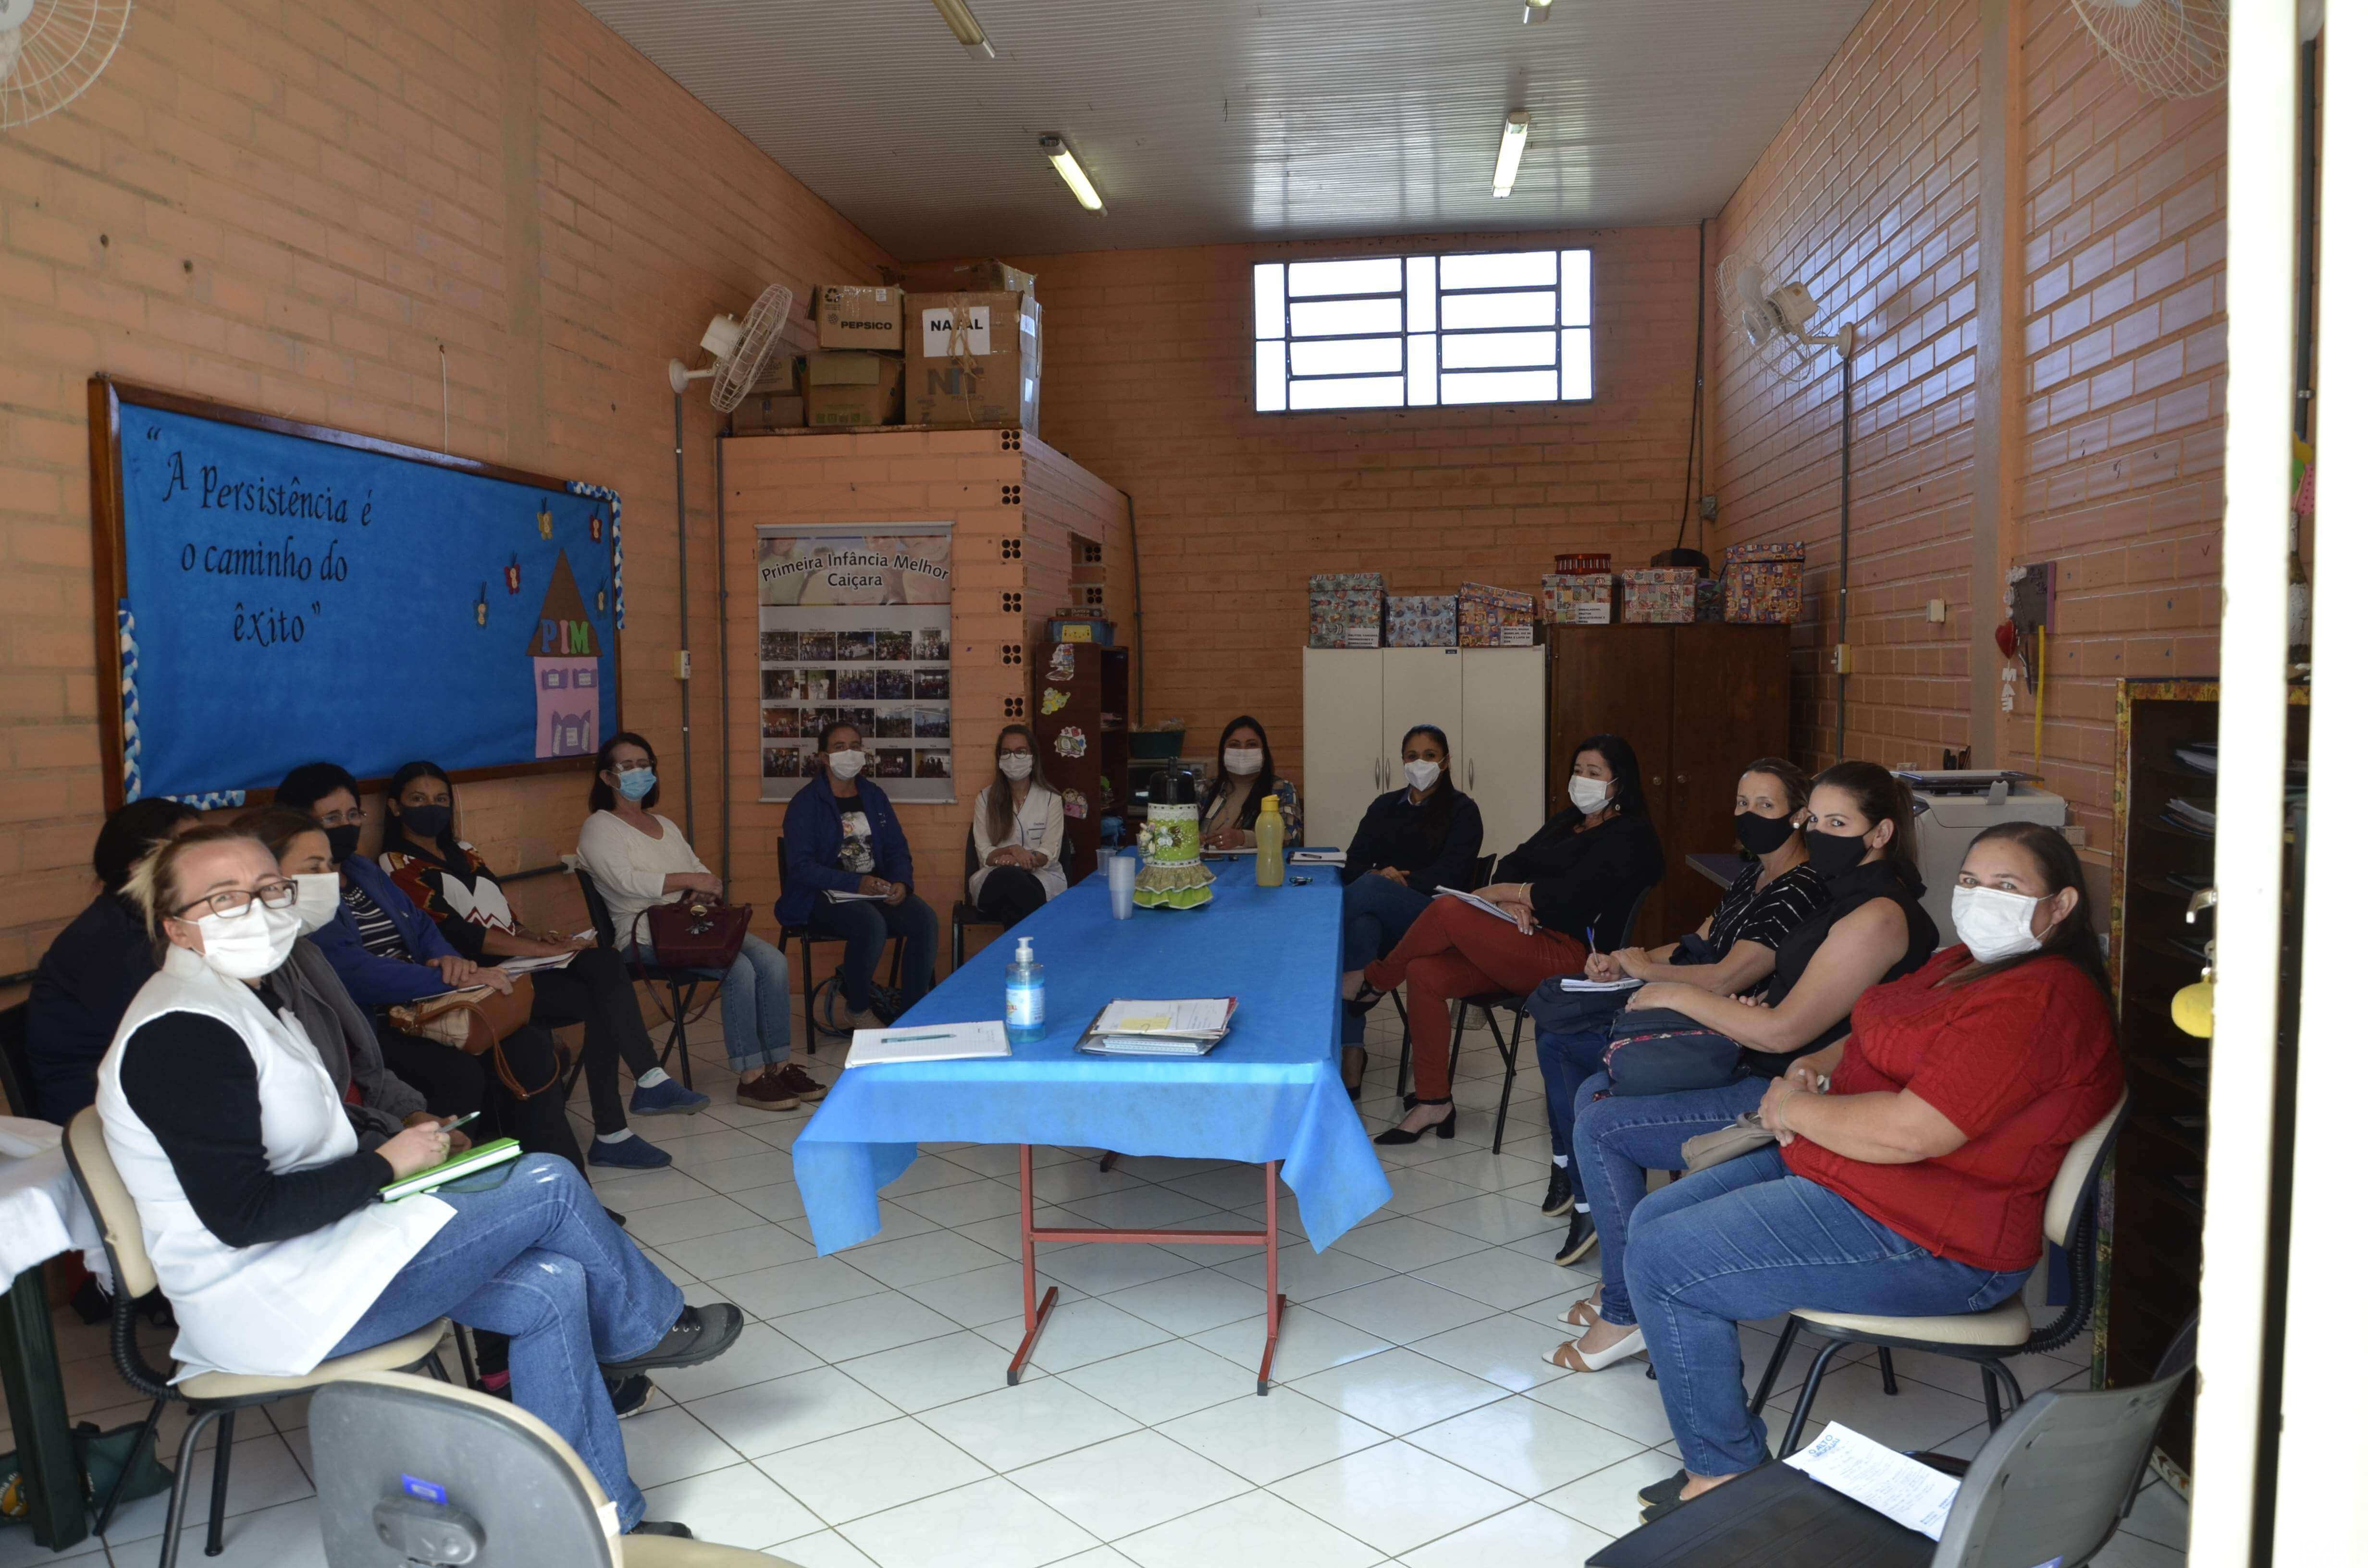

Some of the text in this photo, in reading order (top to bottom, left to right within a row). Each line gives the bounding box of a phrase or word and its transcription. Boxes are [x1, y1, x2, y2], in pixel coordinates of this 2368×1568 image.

[840, 321, 892, 330] PEPSICO
[931, 319, 983, 331] NAAL
[200, 465, 348, 524] Persistência
[361, 489, 372, 527] é
[181, 535, 348, 582] o caminho do
[761, 551, 950, 582] Primeira Infância Melhor
[827, 573, 883, 590] Caiçara
[542, 619, 591, 655] PIM
